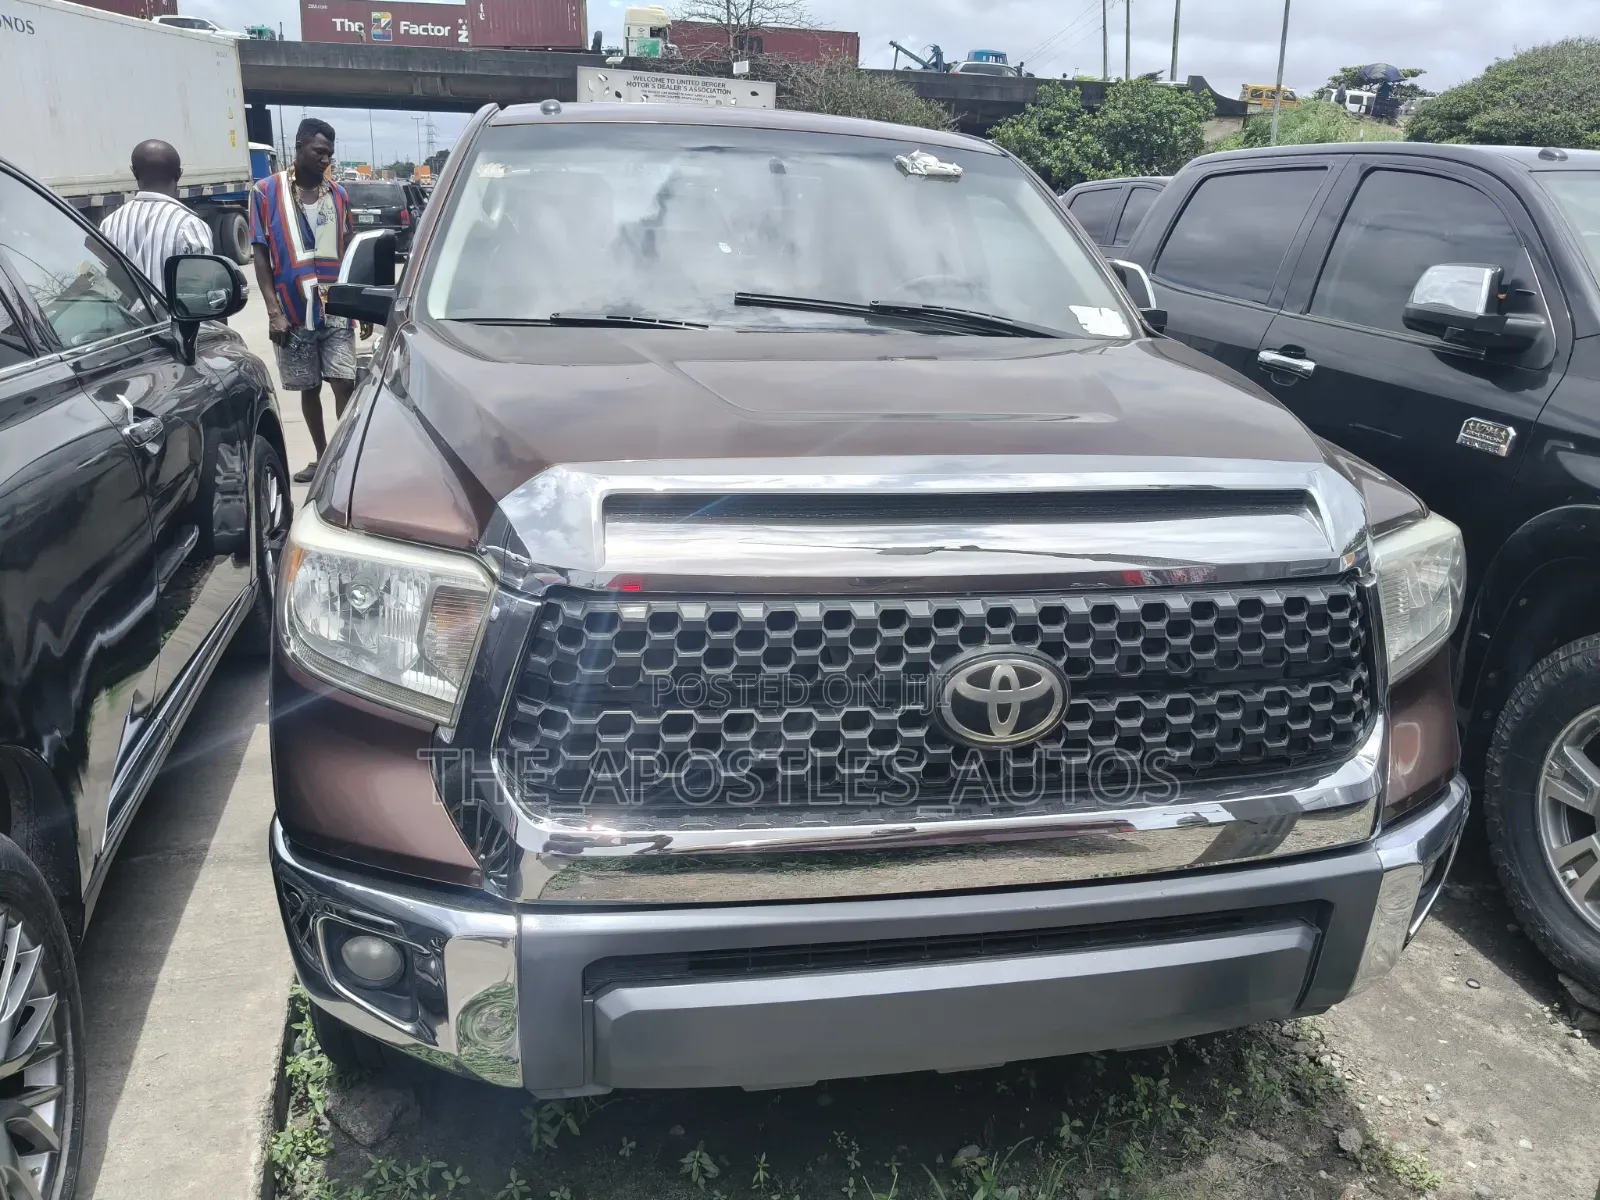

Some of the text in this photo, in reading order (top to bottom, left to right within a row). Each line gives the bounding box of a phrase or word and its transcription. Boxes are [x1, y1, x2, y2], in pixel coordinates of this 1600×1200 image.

[0, 14, 35, 35] NOS
[331, 18, 365, 32] The
[399, 20, 452, 37] Factor
[632, 75, 666, 84] WELCOME
[676, 79, 700, 87] UNITED
[701, 80, 726, 89] BERGER
[688, 86, 732, 95] ASSOCIATION
